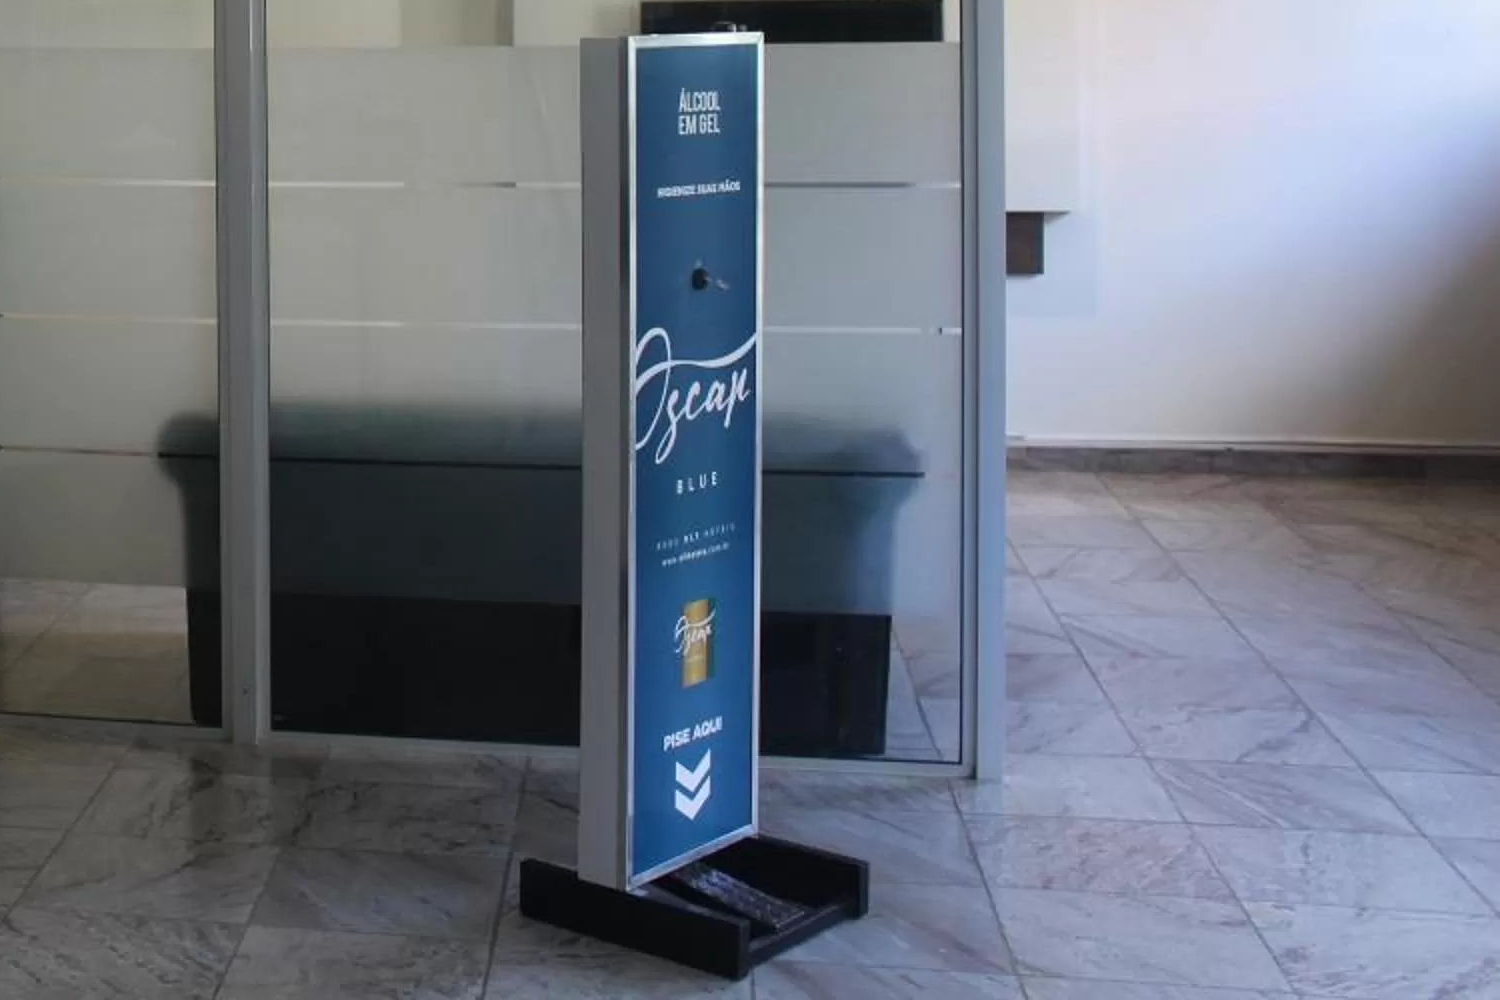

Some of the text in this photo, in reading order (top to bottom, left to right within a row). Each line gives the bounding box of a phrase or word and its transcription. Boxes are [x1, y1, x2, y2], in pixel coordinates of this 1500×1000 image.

[679, 87, 721, 113] ÁLCOOL
[678, 113, 721, 135] EM GEL
[677, 471, 718, 495] BLUE
[663, 715, 723, 751] PISE AQUI
